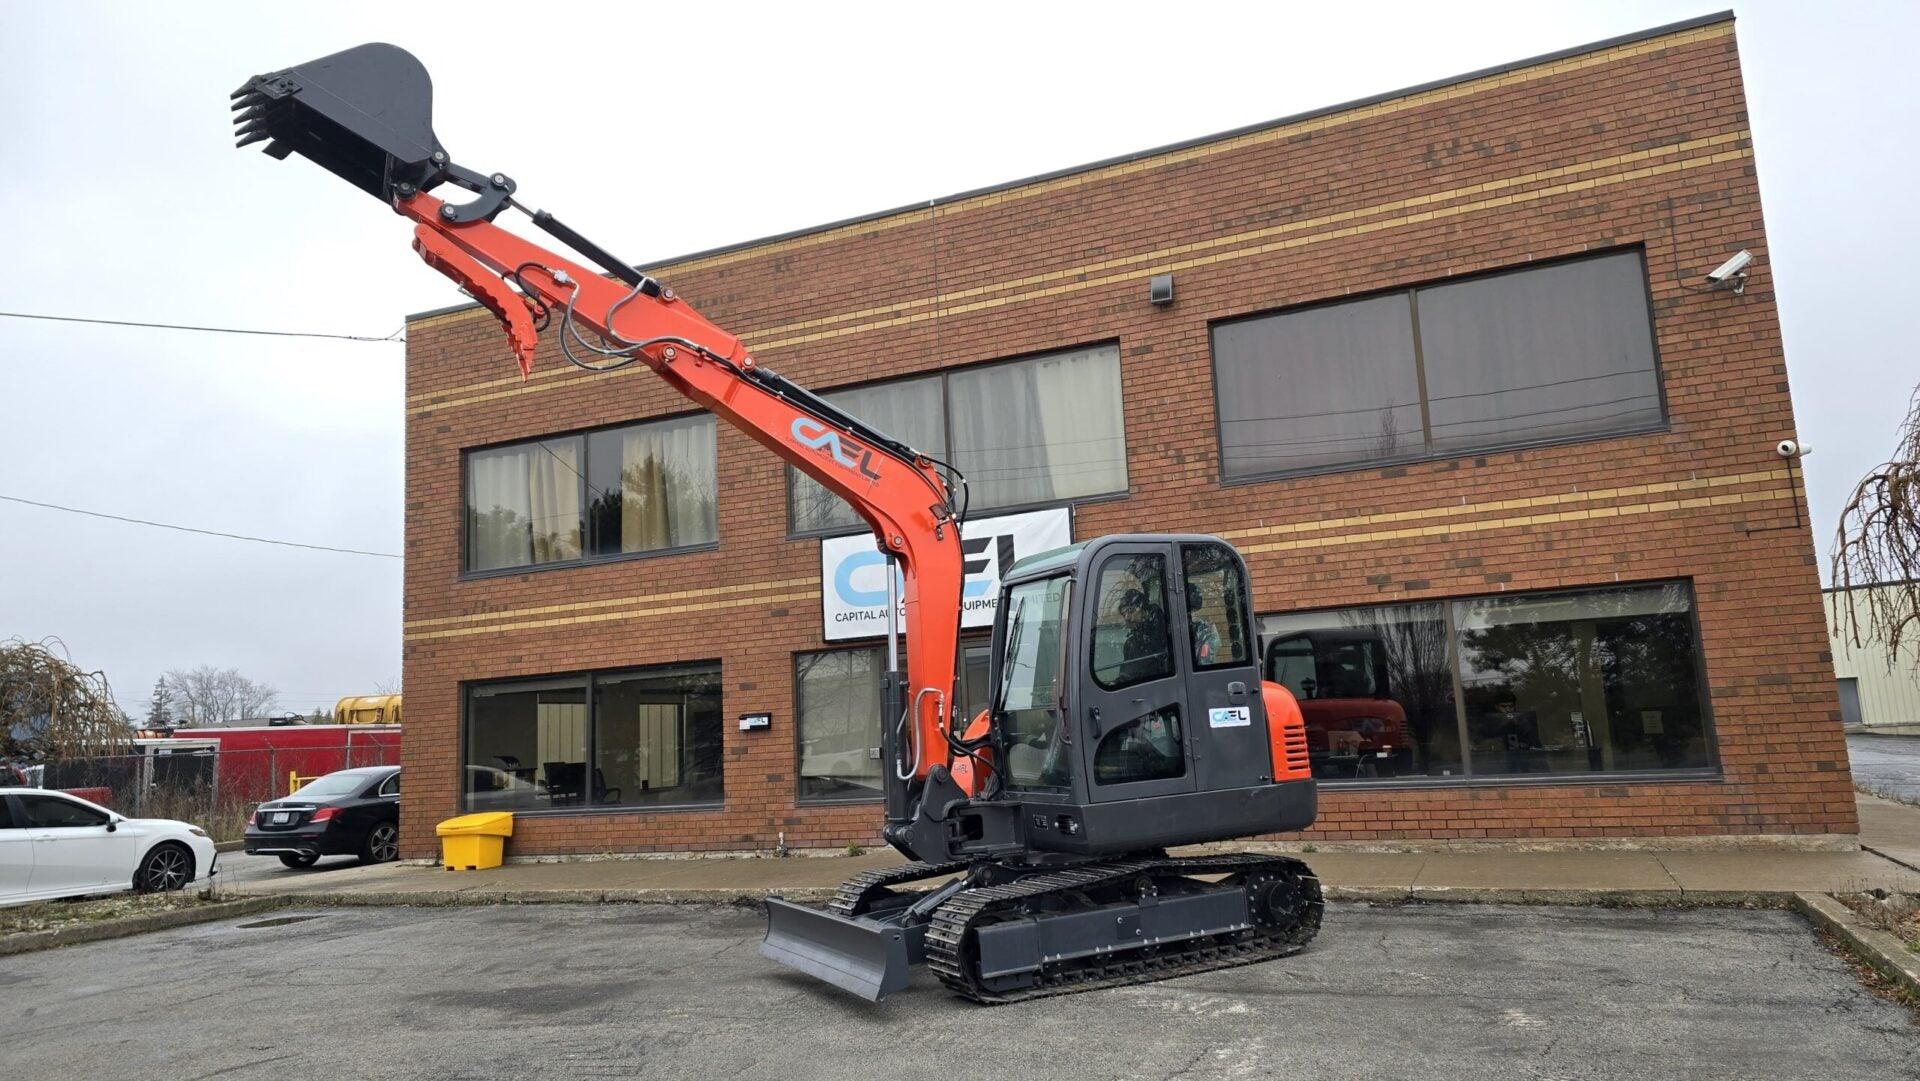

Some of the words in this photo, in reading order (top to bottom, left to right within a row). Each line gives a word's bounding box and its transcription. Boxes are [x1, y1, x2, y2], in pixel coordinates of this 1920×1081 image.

[791, 417, 881, 480] CAEL
[835, 610, 877, 622] CAPITAL
[1212, 710, 1247, 722] CAEL
